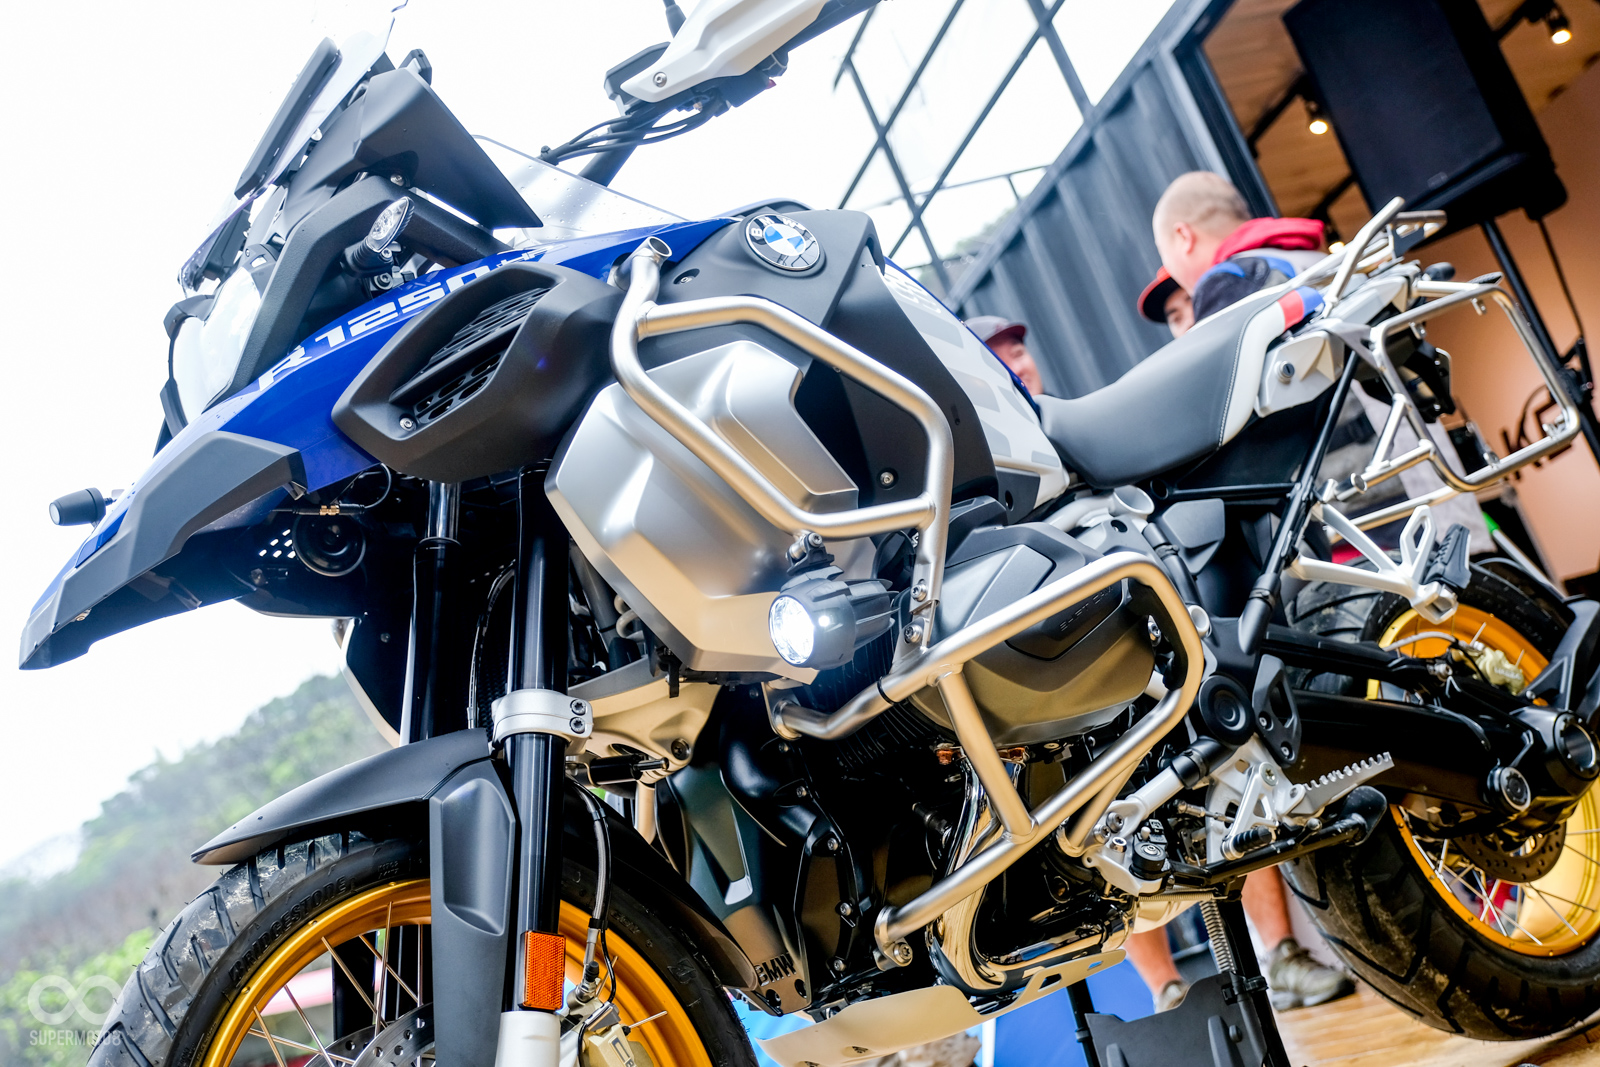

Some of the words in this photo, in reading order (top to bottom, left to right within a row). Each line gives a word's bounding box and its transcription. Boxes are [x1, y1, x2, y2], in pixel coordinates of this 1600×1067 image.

[259, 345, 312, 391] R
[228, 875, 347, 988] BRIDGESTONE
[753, 952, 797, 987] BMW
